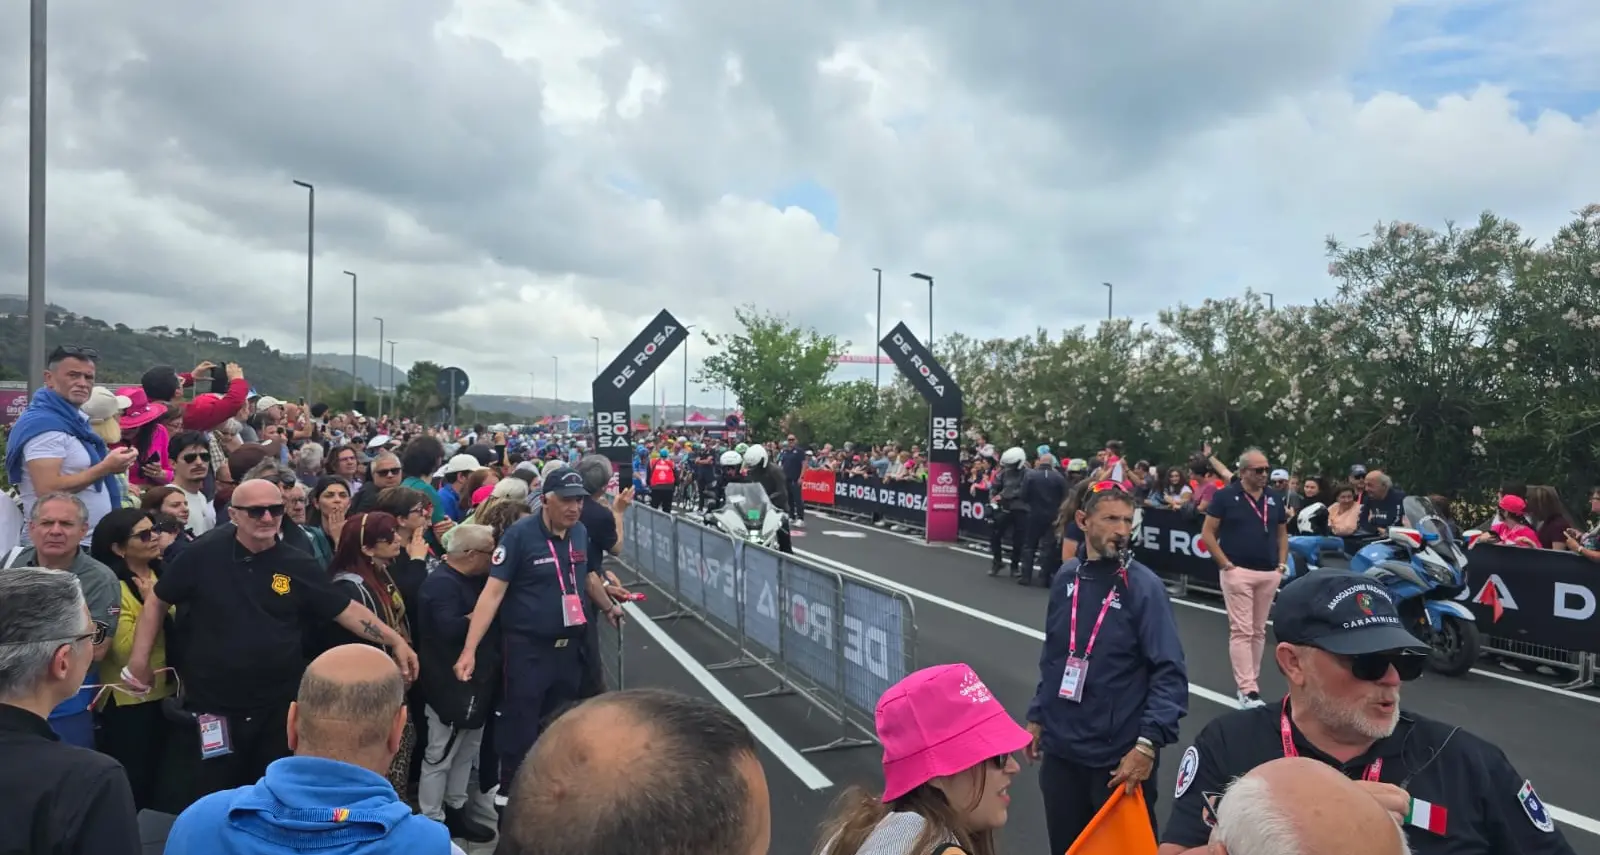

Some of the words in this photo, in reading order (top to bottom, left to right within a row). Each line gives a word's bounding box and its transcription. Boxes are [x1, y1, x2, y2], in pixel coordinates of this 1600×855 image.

[612, 365, 635, 388] DE
[633, 325, 677, 367] ROSA
[892, 333, 912, 355] DE
[910, 354, 945, 397] ROSA
[597, 412, 626, 424] DE
[933, 417, 958, 429] DE
[598, 424, 628, 435] RO
[933, 428, 958, 440] RO
[598, 436, 629, 448] SA
[933, 440, 958, 450] SA
[835, 482, 847, 496] DE
[849, 484, 877, 502] ROSA
[879, 488, 896, 505] DE
[961, 500, 985, 520] RO
[1169, 529, 1213, 559] RO
